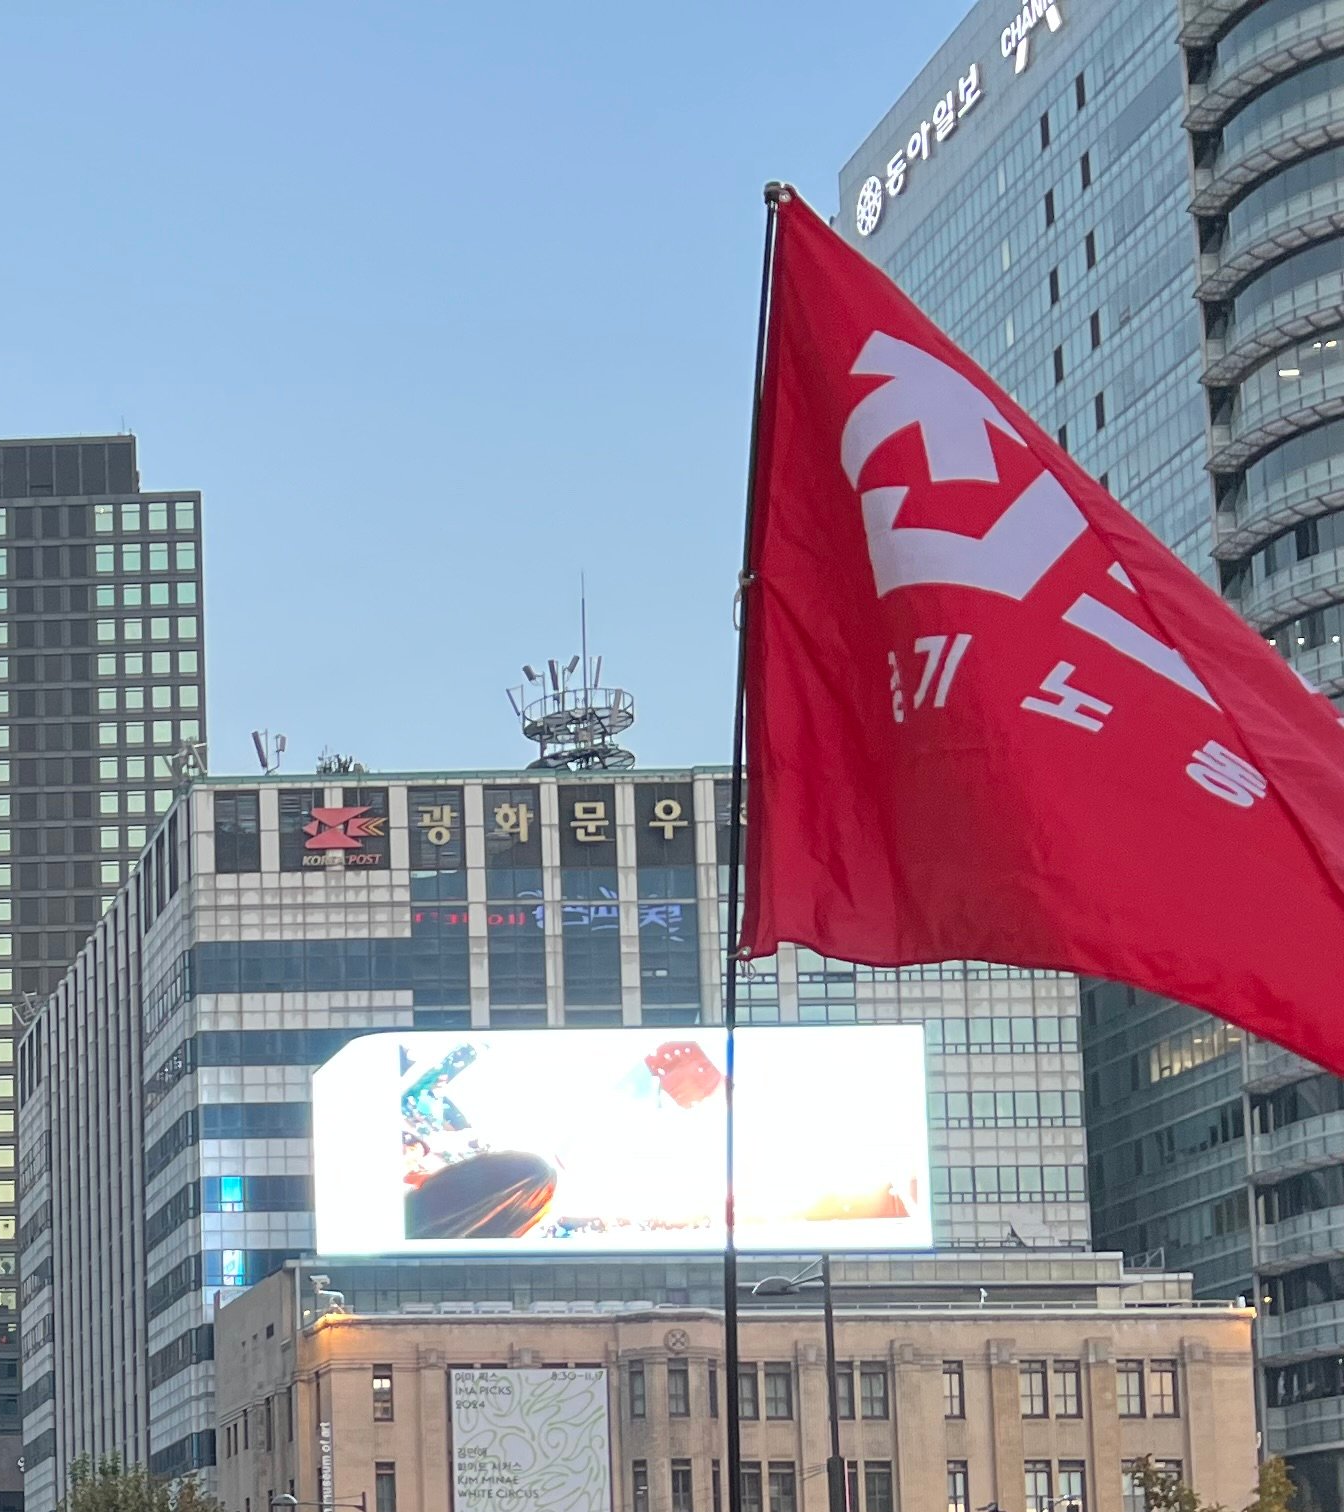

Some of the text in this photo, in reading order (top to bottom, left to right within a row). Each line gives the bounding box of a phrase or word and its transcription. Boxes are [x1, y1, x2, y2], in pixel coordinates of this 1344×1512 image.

[885, 63, 982, 197] 동아일보
[416, 799, 748, 846] 광화문우
[348, 854, 382, 865] POST
[480, 1386, 512, 1396] PICKS
[455, 1400, 485, 1410] 2024
[320, 1421, 331, 1438] art
[320, 1439, 332, 1452] of
[321, 1455, 333, 1505] museum
[457, 1476, 479, 1485] KIM
[458, 1489, 540, 1499] WHITE CIRCUS
